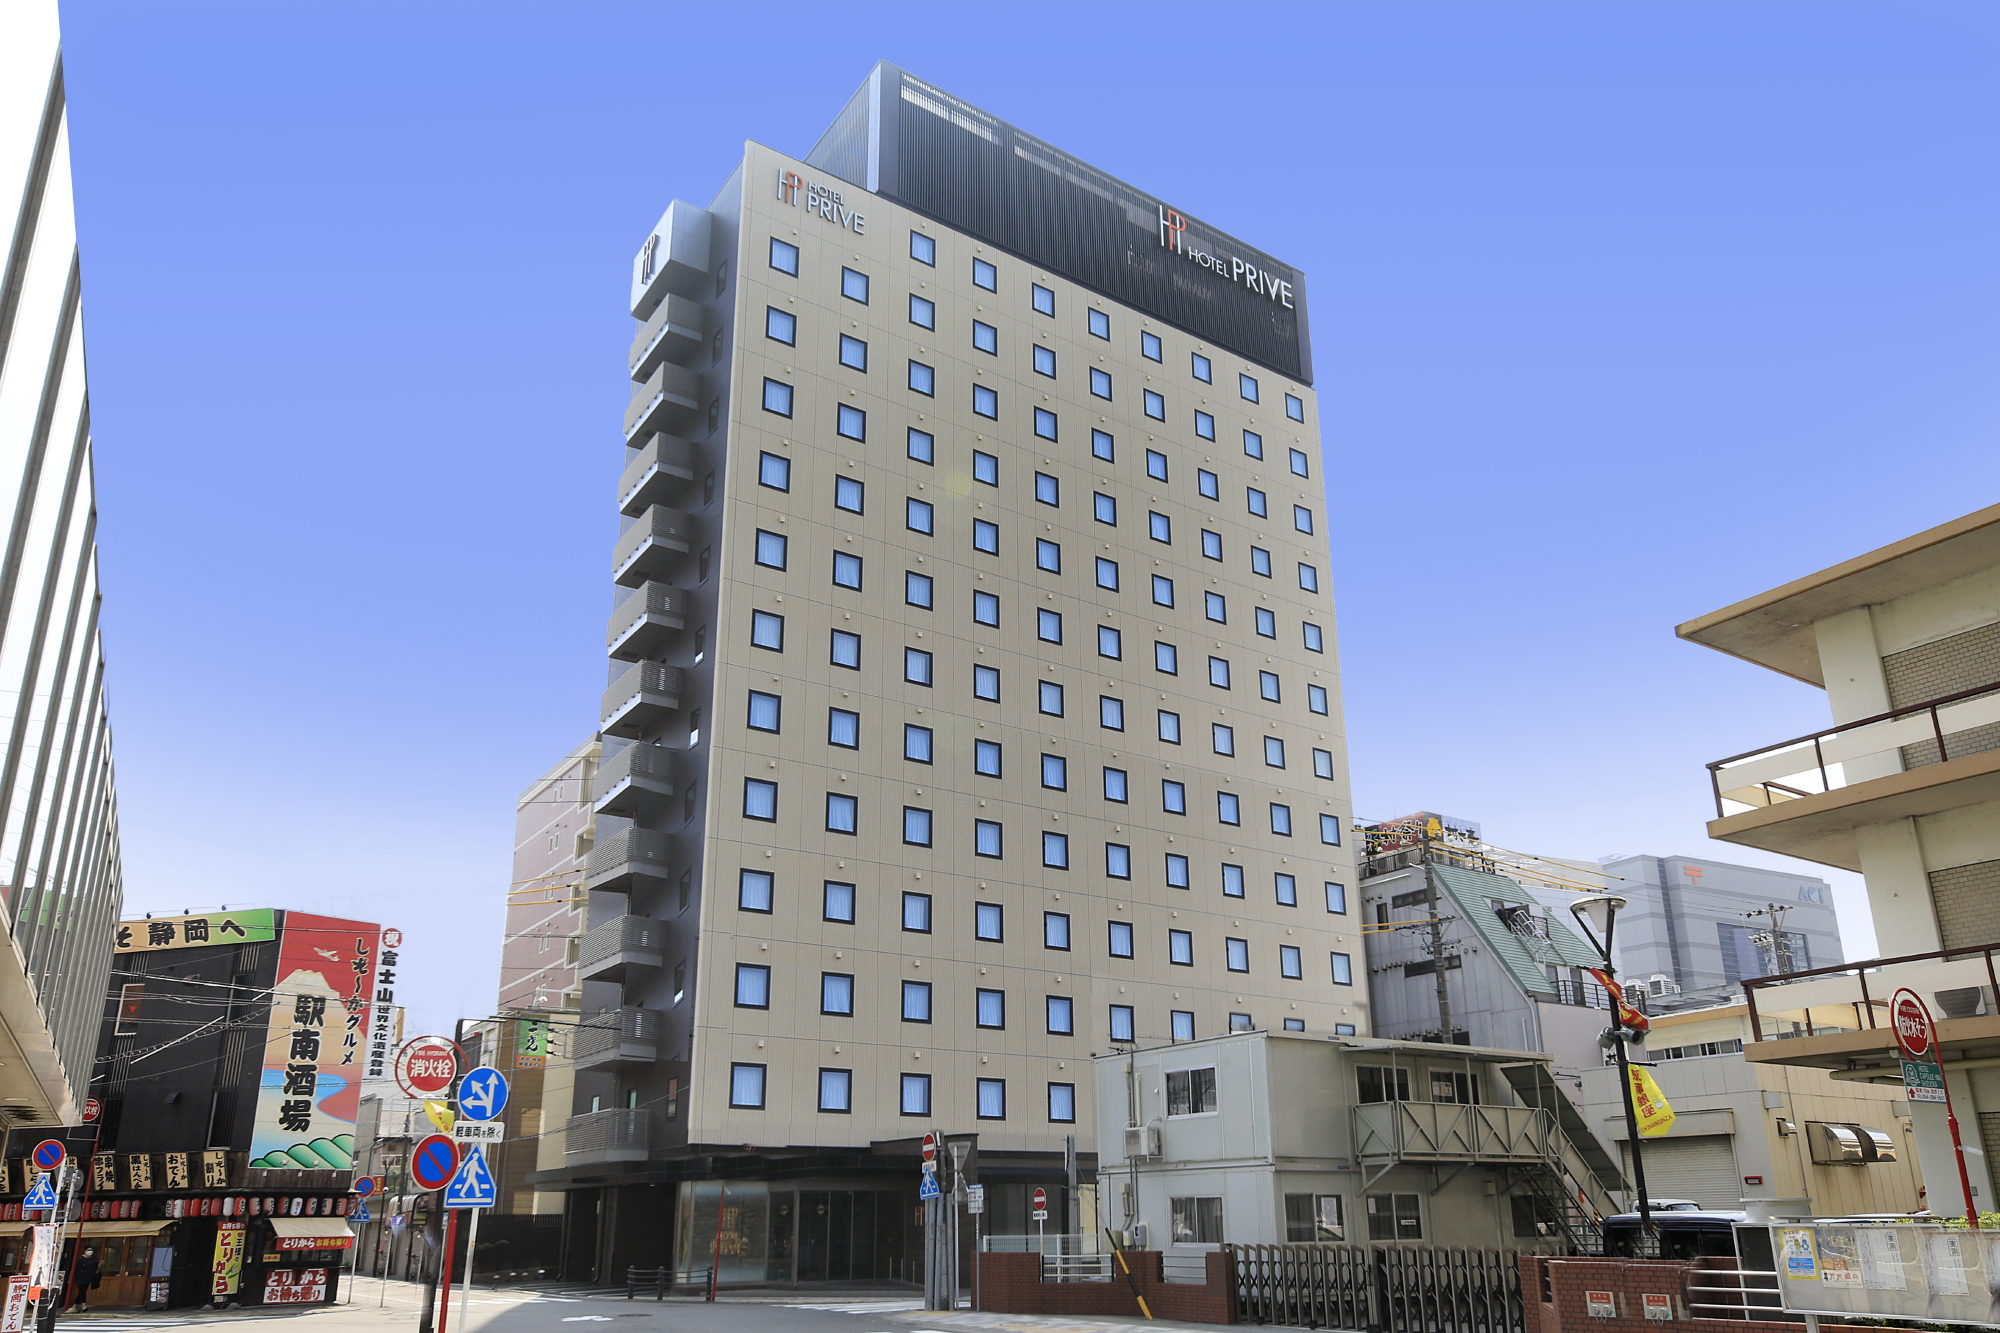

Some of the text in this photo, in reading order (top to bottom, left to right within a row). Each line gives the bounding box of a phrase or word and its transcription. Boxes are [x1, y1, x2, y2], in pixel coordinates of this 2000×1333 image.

[808, 180, 844, 206] HOTEL
[807, 195, 865, 235] PRIVE
[1188, 246, 1293, 309] HOTEL PRIVE
[384, 931, 400, 947] 祝
[279, 994, 326, 1132] 駅南酒場
[410, 1059, 453, 1078] 消火栓
[455, 1126, 501, 1138] 軽車両を除く
[168, 1155, 180, 1187] おでん
[282, 1238, 348, 1249] とりから お持ち帰り
[216, 1232, 234, 1293] とりから
[6, 1284, 23, 1330] 静岡おでん
[267, 1286, 320, 1301] お持ち帰り
